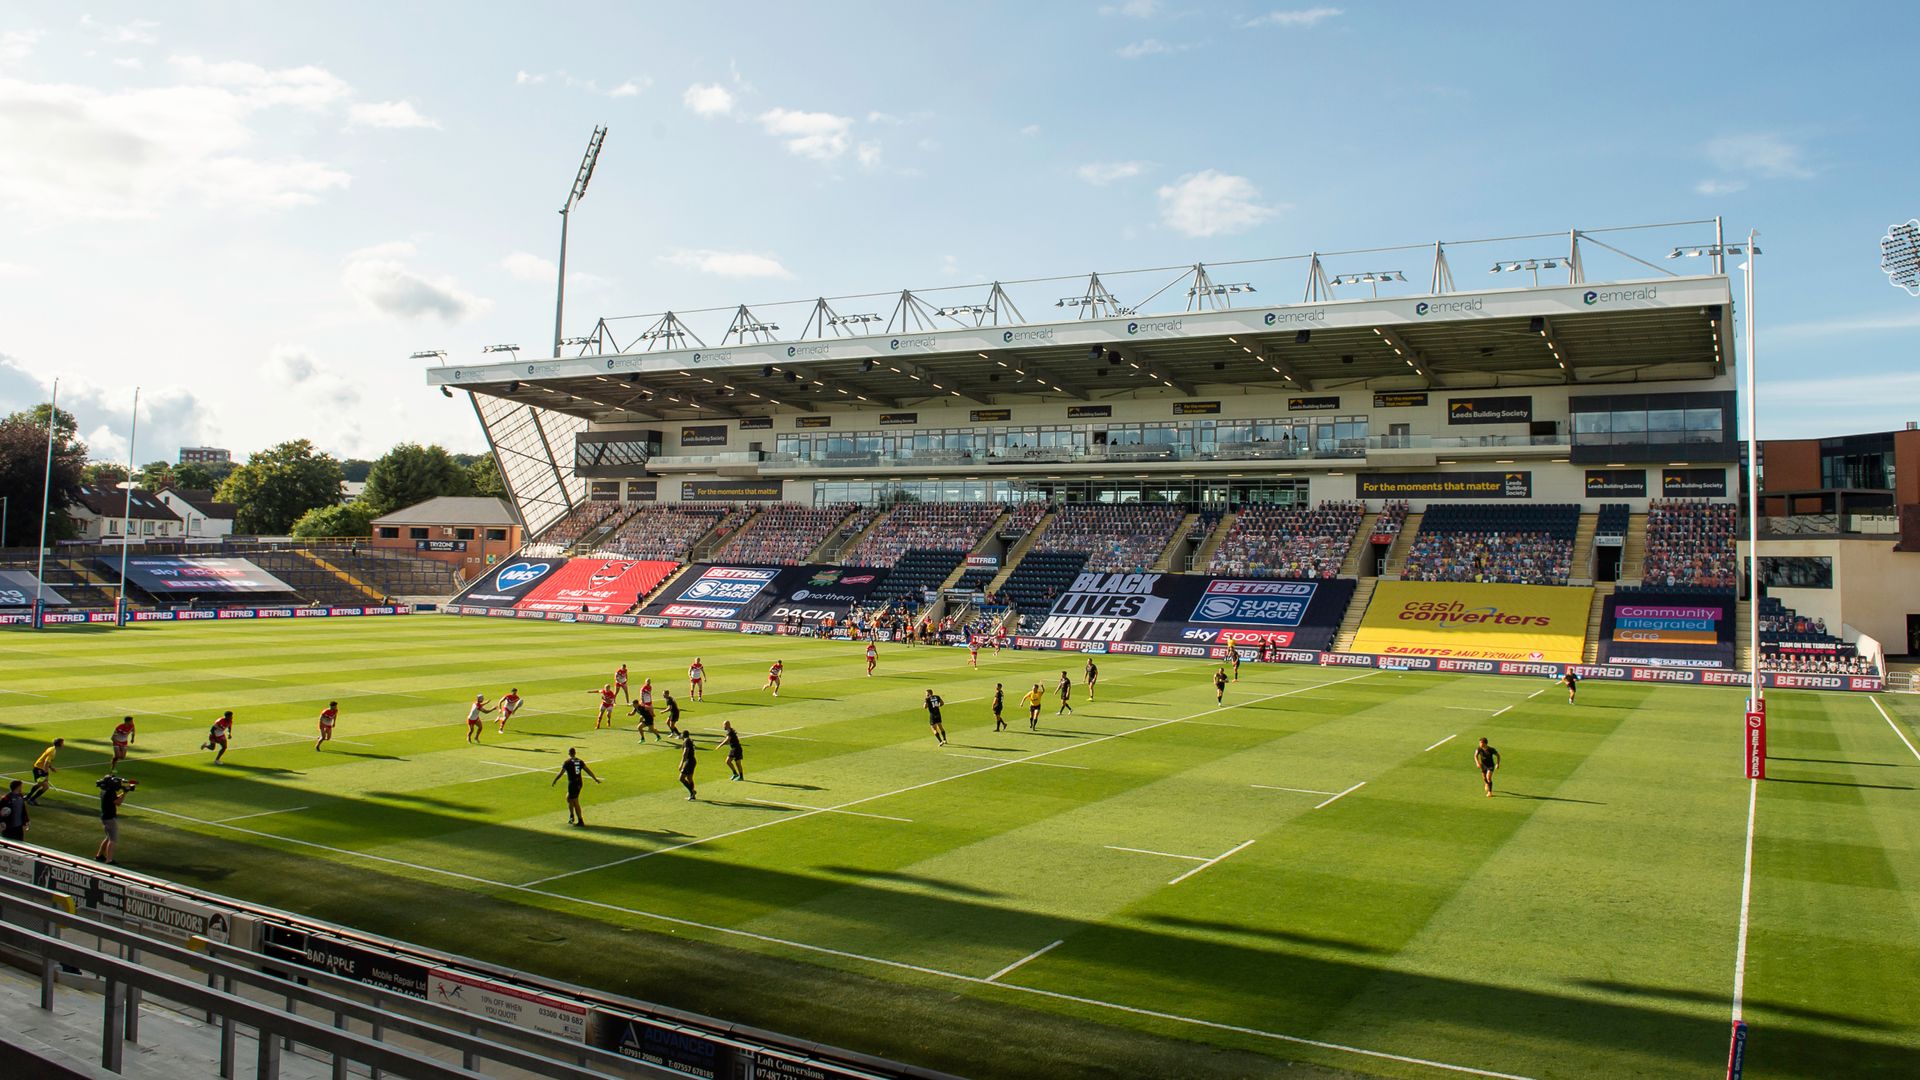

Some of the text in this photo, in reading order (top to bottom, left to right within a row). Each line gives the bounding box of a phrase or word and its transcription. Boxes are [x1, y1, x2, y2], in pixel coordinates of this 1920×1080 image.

[1600, 287, 1657, 303] emerald
[1431, 298, 1482, 313] emerald
[1277, 309, 1325, 323] emerald
[1139, 320, 1182, 333] emerald
[1014, 328, 1053, 341] emerald
[900, 336, 936, 349] emerald
[796, 344, 830, 355] emerald
[1502, 410, 1528, 418] Society
[1364, 483, 1378, 491] For
[1380, 482, 1395, 491] the
[1397, 483, 1442, 491] moments
[1444, 482, 1464, 490] that
[967, 556, 996, 564] BETFRED
[502, 570, 539, 580] NHS
[706, 569, 776, 579] BETFRED
[719, 583, 761, 592] SUPER
[1068, 574, 1162, 593] BLACK
[1212, 582, 1311, 594] BETFRED
[713, 590, 755, 599] LEAGUE
[808, 592, 854, 601] northern
[1053, 595, 1145, 616] LIVES
[1240, 600, 1302, 611] SUPER
[1404, 601, 1465, 612] cash
[136, 611, 174, 620] BETFRED
[179, 610, 215, 619] BETFRED
[220, 610, 254, 618] BETFRED
[259, 609, 291, 617] BETFRED
[490, 608, 514, 616] BETFRED
[518, 610, 544, 618] BETFRED
[664, 606, 736, 618] BETFRED
[1236, 609, 1299, 620] LEAGUE
[1622, 608, 1715, 619] Community
[45, 614, 85, 622] BETFRED
[608, 615, 635, 623] BETFRED
[672, 619, 702, 628] BETFRED
[1398, 611, 1550, 626] converters
[706, 621, 737, 630] BETFRED
[741, 623, 773, 632] BETFRED
[1035, 616, 1132, 641] MATTER
[1624, 619, 1706, 629] Integrated
[1183, 629, 1288, 644] sky sports
[1620, 631, 1659, 640] Care
[1017, 638, 1057, 648] BETFRED
[1063, 641, 1104, 650] BETFRED
[1111, 643, 1153, 653] BETFRED
[1160, 646, 1204, 656] BETFRED
[1384, 646, 1452, 656] SAINTS
[1321, 653, 1370, 664] BETFRED
[1379, 657, 1430, 668] BETFRED
[1440, 660, 1492, 672] BETFRED
[1502, 663, 1557, 674] BETFRED
[1634, 669, 1694, 681] BETFRED
[1777, 676, 1841, 687] BETFRED
[1852, 678, 1881, 688] BET
[51, 867, 91, 888] SILVERBACK
[126, 898, 158, 919] GOWILD
[158, 907, 202, 932] OUTDOORS
[307, 948, 355, 974] BAD APPLE
[372, 968, 393, 981] Mobile
[394, 974, 415, 987] Repair
[416, 981, 426, 991] Ltd
[481, 996, 522, 1012] 10% OFF WHEN
[486, 1007, 497, 1015] YOU
[498, 1009, 517, 1020] QUOTE
[571, 1016, 583, 1025] 682
[757, 1055, 824, 1080] Loft Conversions
